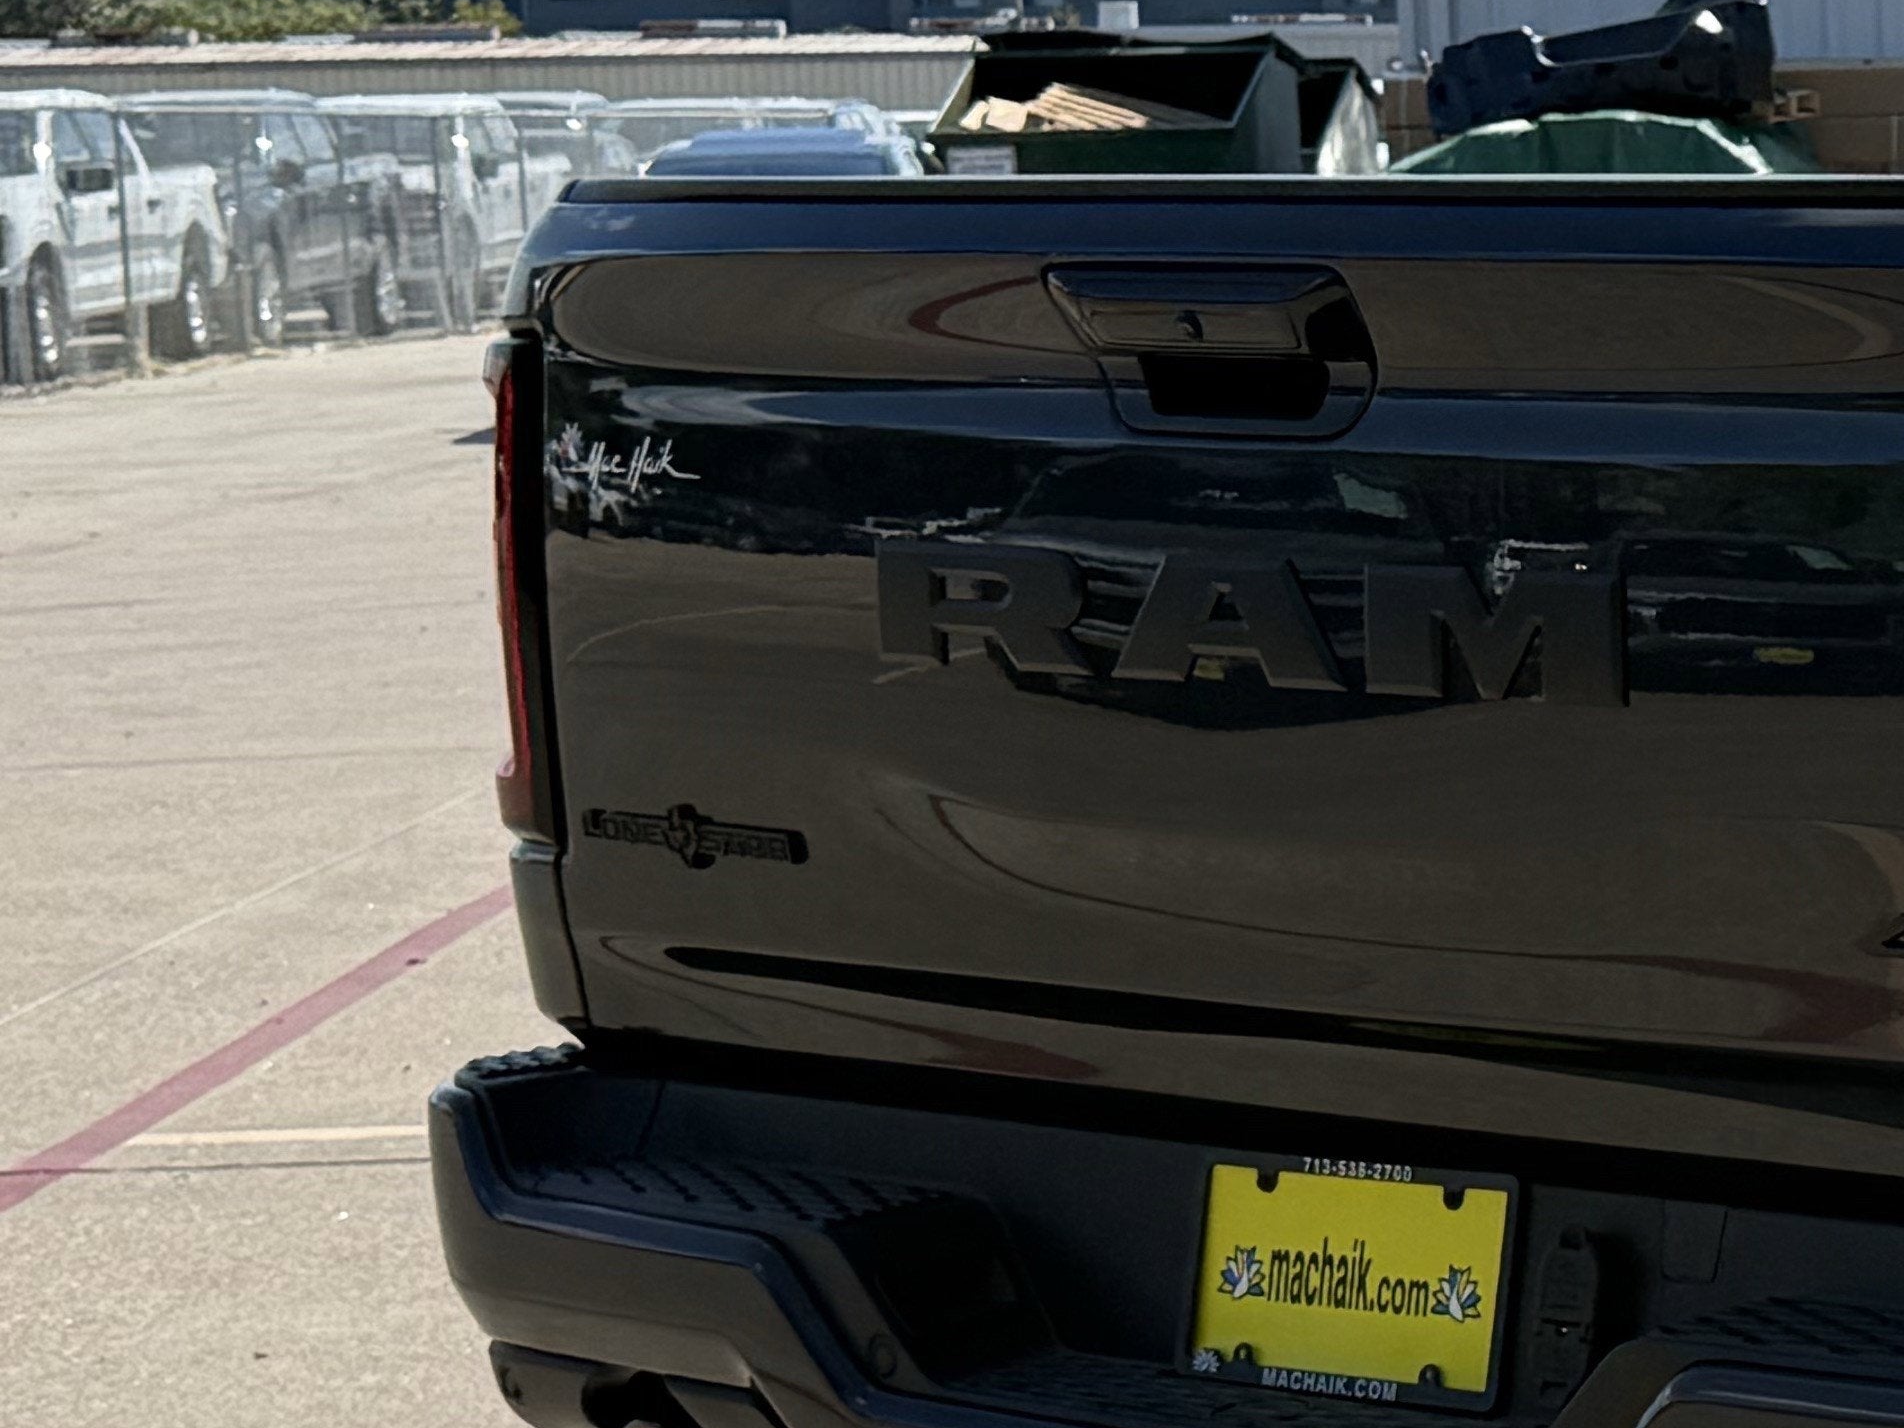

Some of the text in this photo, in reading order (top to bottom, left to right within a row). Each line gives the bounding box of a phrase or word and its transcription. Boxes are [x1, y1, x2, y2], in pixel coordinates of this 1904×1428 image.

[875, 536, 1630, 706] RAM
[583, 809, 663, 846] LONE
[1266, 1236, 1430, 1317] machaik.com
[1261, 1368, 1398, 1402] MACHAIK.COM
